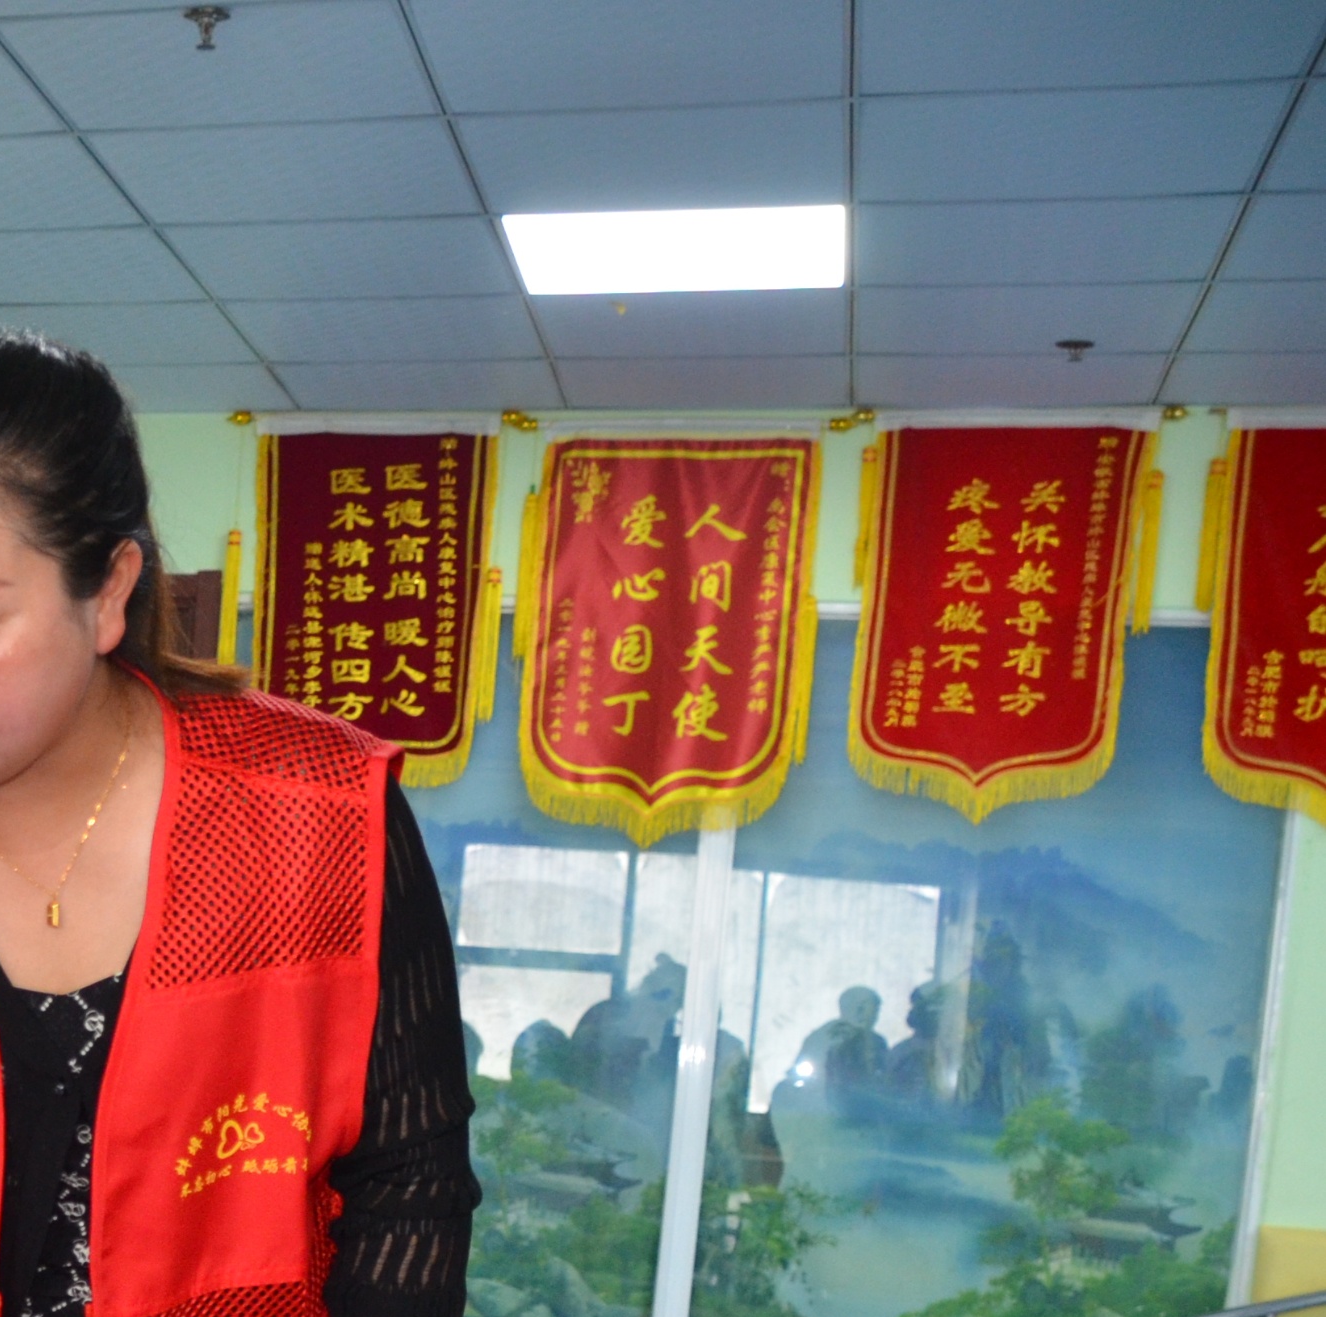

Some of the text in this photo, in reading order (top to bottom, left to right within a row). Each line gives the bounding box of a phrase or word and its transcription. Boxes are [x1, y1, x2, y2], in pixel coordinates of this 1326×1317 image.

[603, 495, 666, 735] 爱心园丁
[671, 503, 746, 742] 人间天使
[932, 478, 1000, 715] 疼爱无微不至
[1000, 479, 1065, 717] 关怀教导有方
